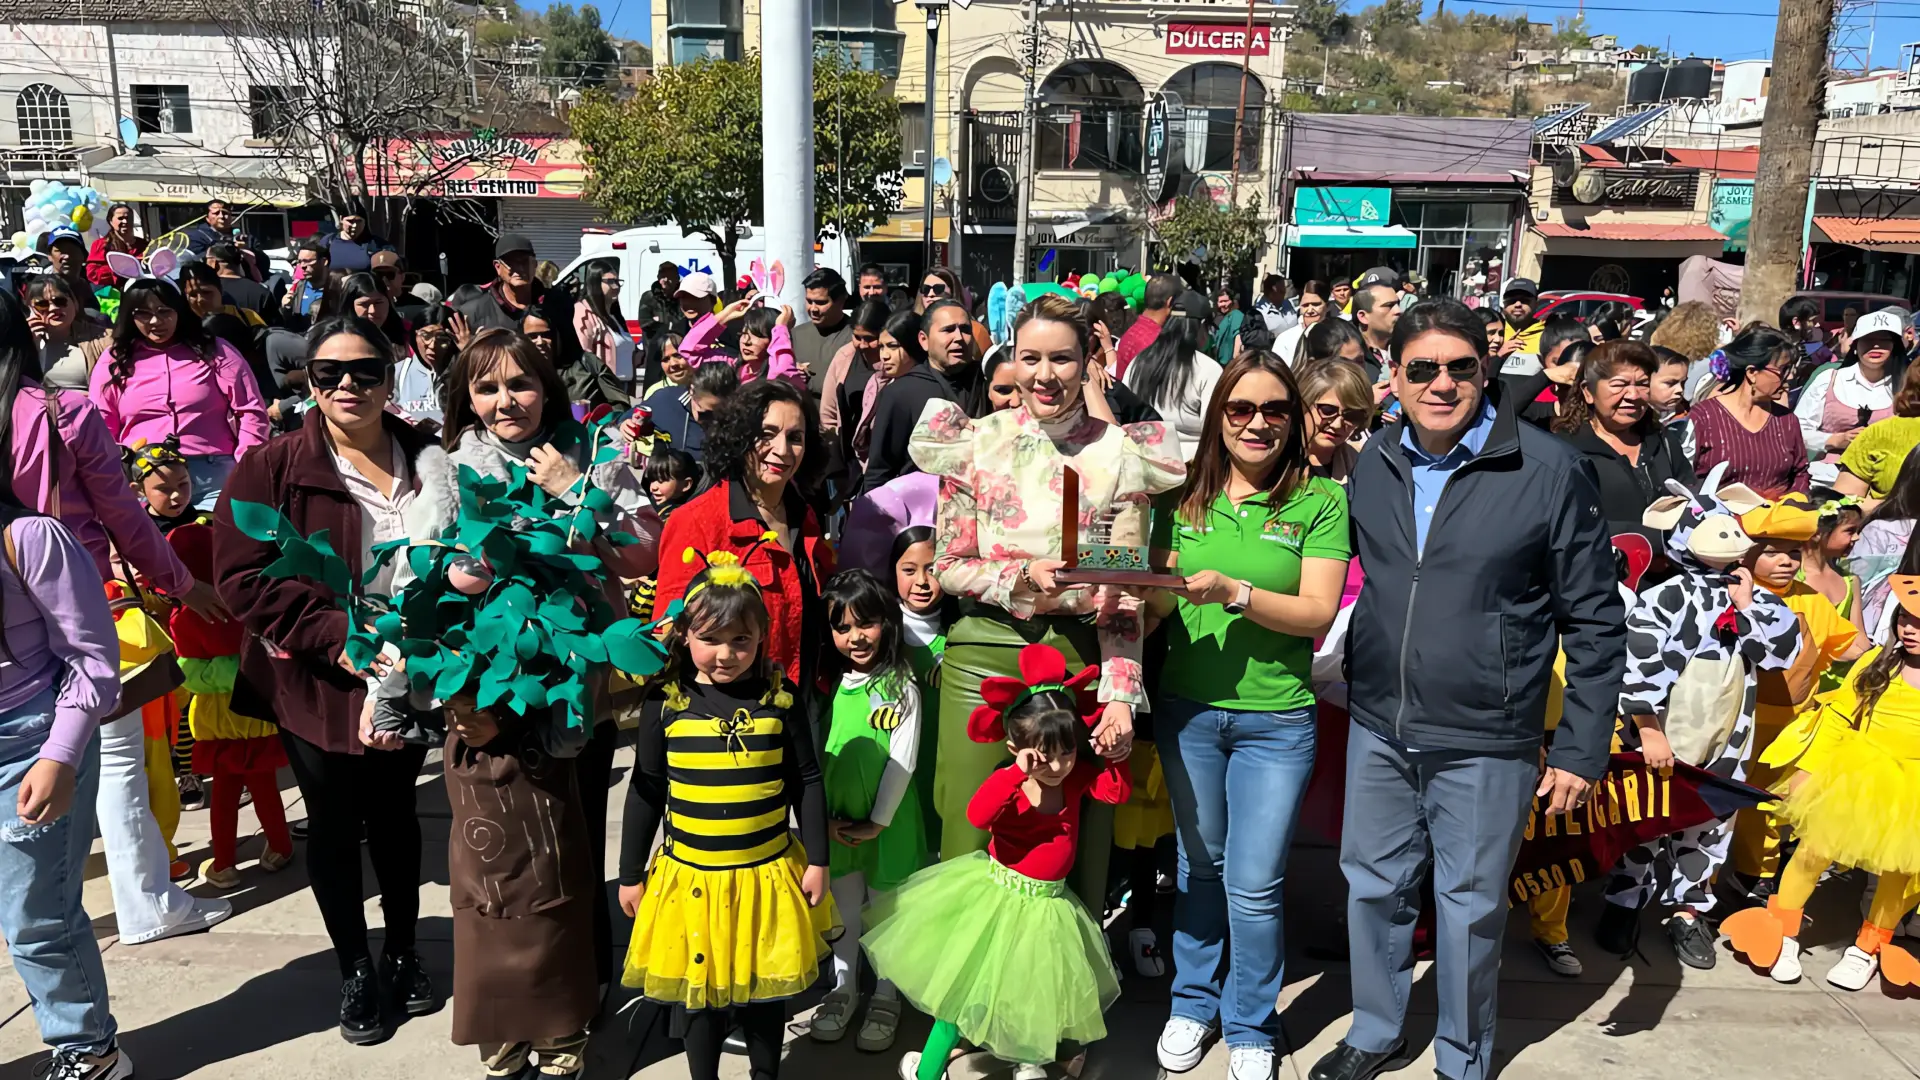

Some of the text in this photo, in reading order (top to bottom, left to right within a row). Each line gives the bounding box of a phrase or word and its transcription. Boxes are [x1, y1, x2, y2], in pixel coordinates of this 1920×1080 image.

[1169, 31, 1265, 49] DULCERA
[479, 180, 537, 194] CENTRO
[1508, 864, 1566, 908] 0530
